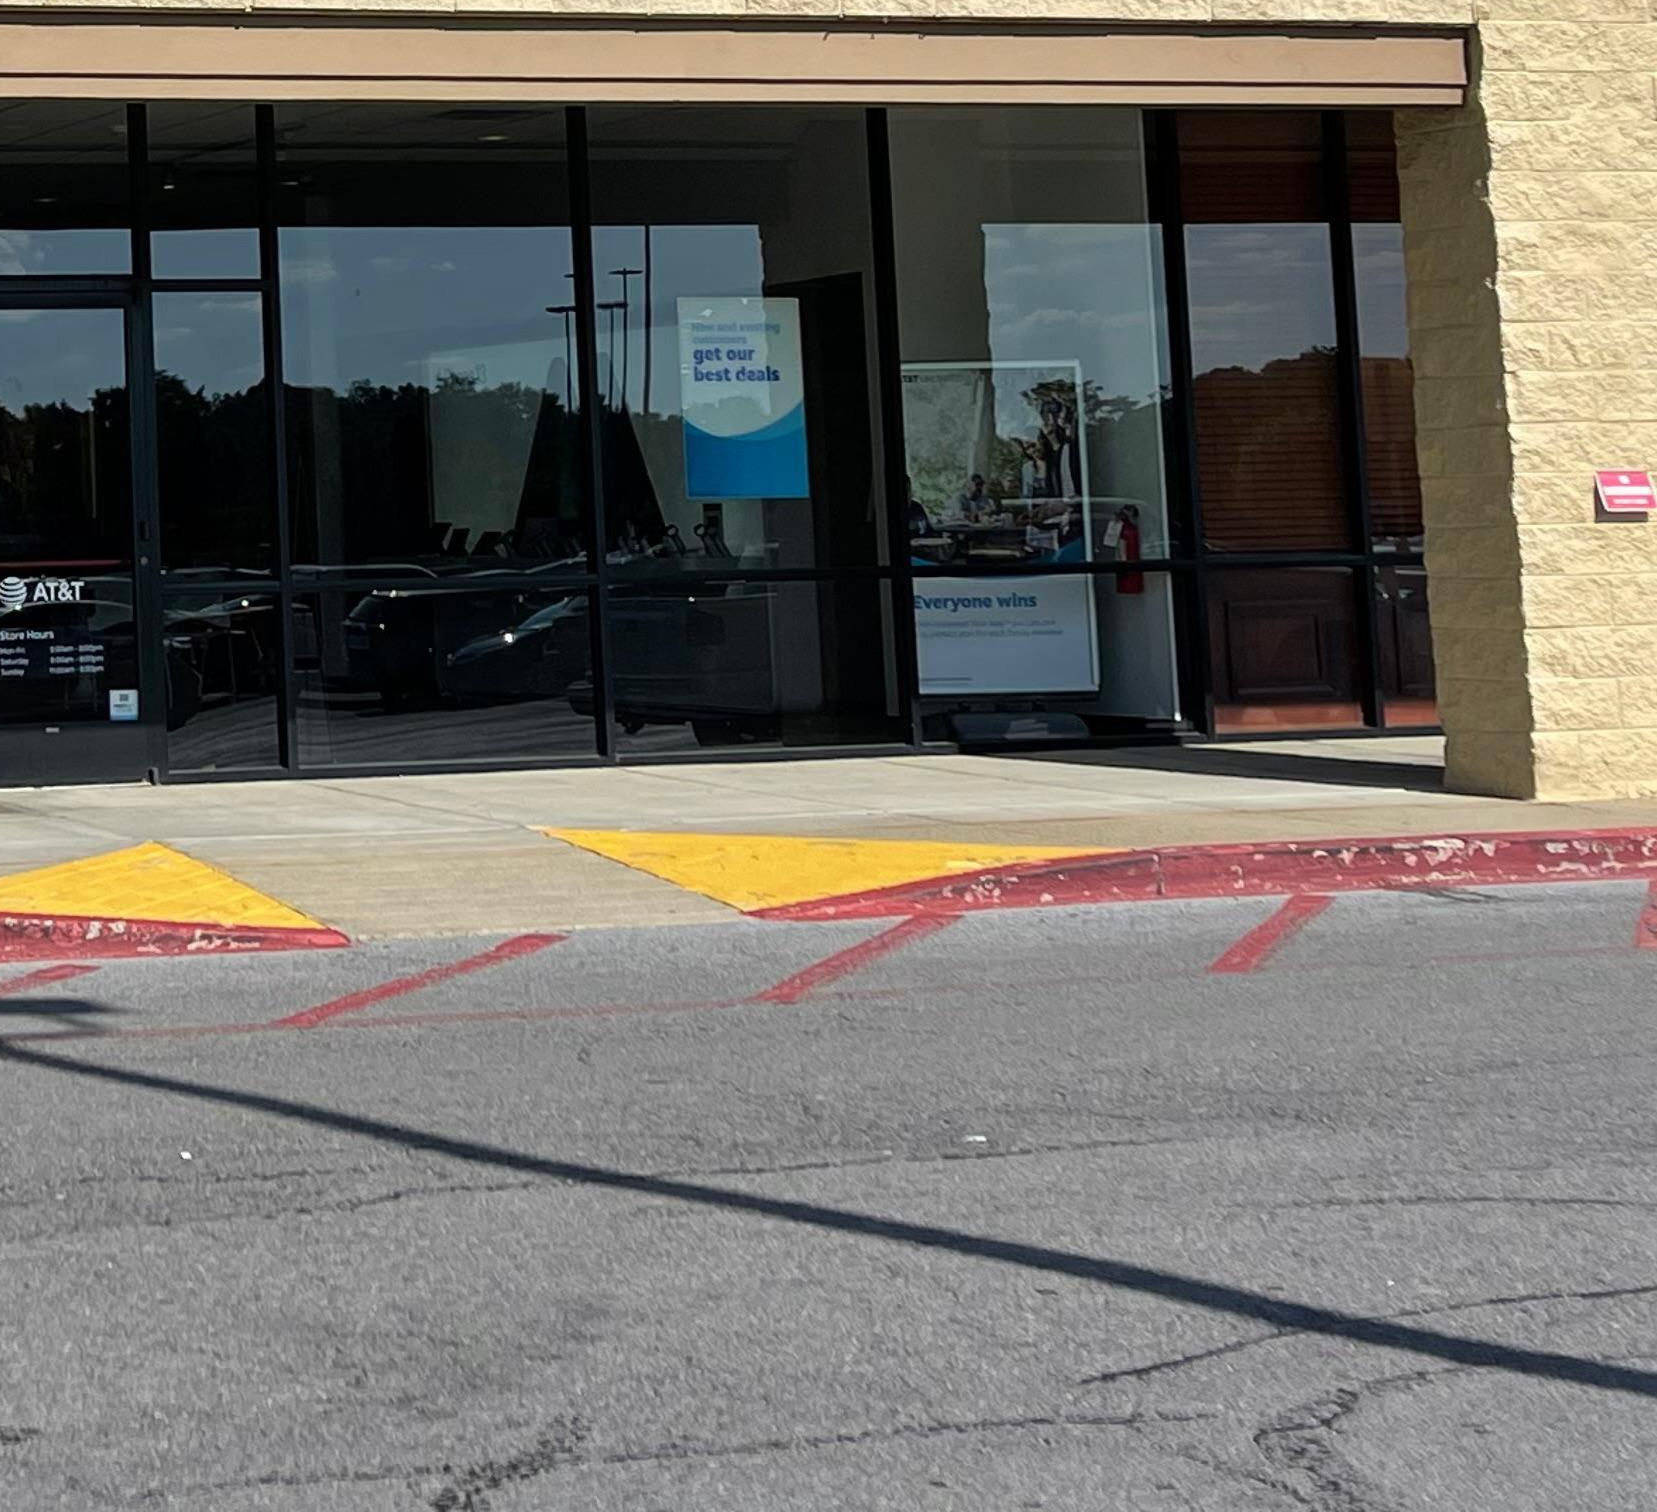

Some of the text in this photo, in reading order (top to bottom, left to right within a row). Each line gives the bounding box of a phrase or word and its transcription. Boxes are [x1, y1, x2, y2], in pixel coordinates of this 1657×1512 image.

[693, 348, 755, 365] get our
[694, 365, 781, 381] best deals
[33, 581, 85, 601] AT&T
[913, 592, 1038, 612] Everyone wins
[0, 630, 54, 641] Store Hours
